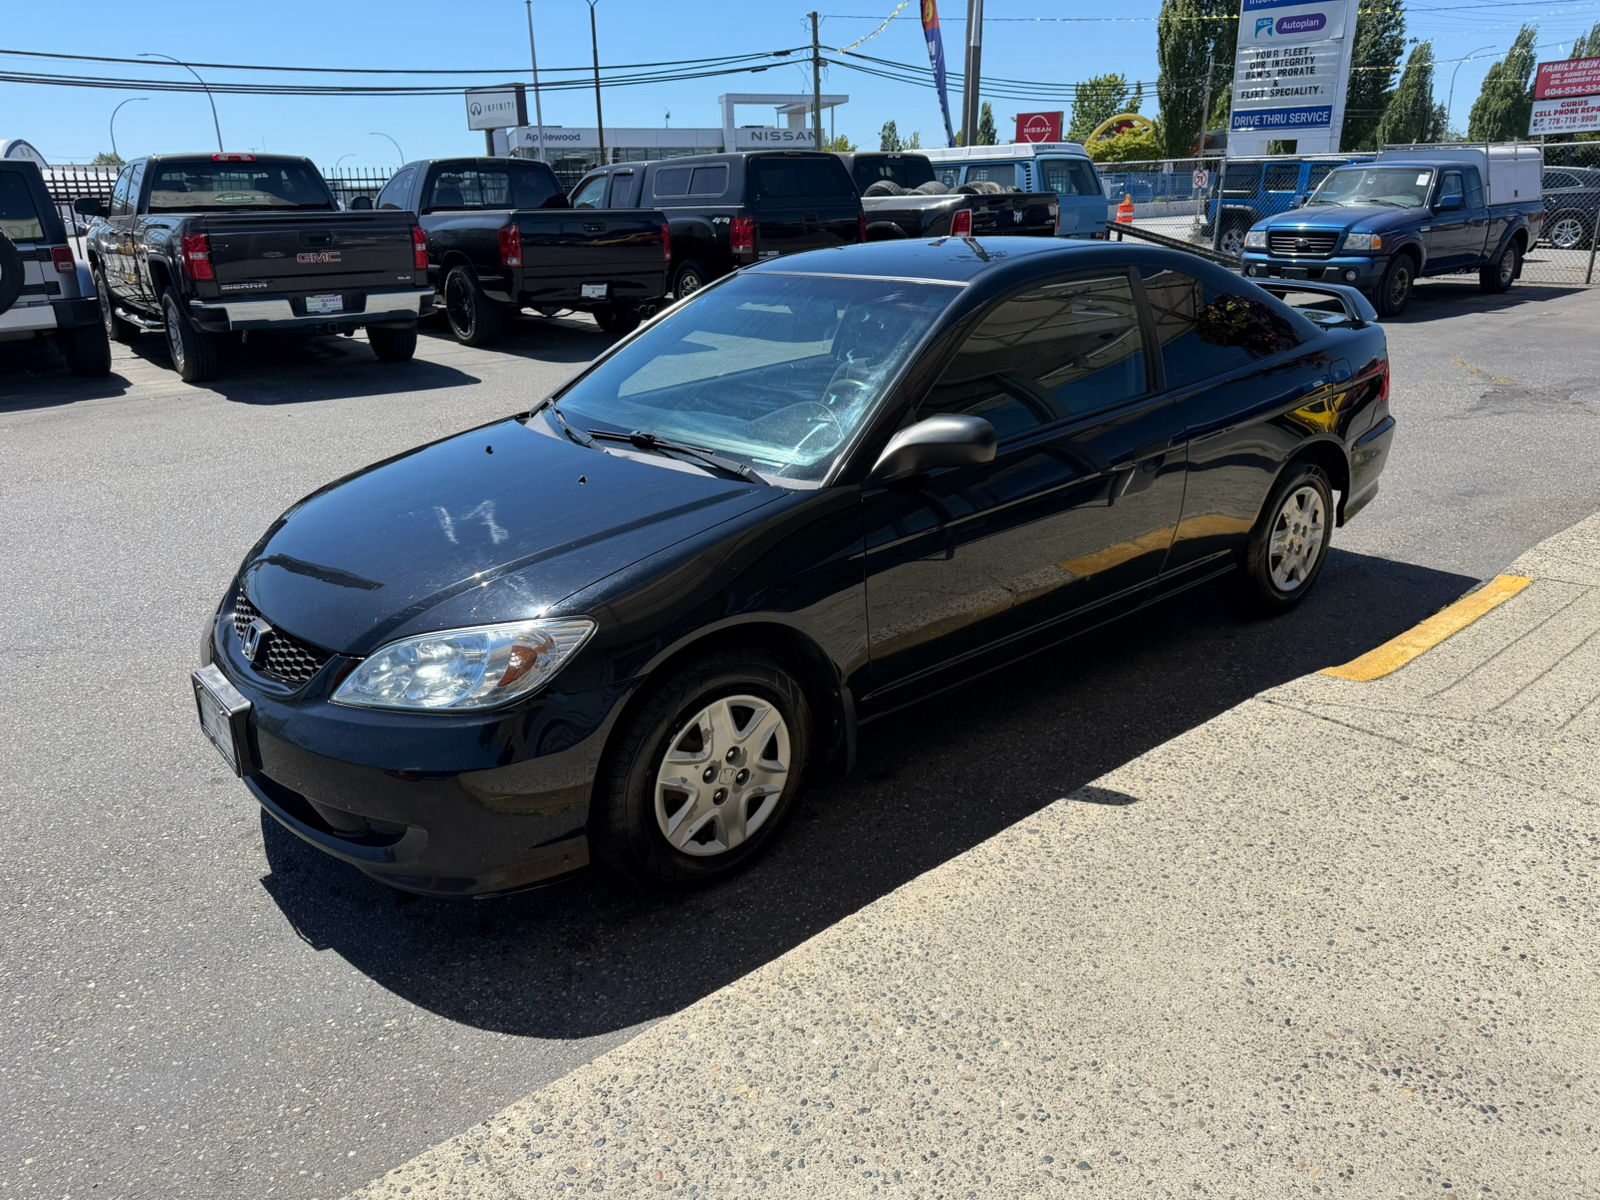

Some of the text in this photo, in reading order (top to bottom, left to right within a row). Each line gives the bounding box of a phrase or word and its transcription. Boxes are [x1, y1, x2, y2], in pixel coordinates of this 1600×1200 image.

[1281, 18, 1320, 31] Autoplan
[1255, 49, 1280, 60] YOUR
[1249, 56, 1316, 70] OUR INTEGRITY
[1542, 60, 1600, 73] FAMILY DEN
[1277, 66, 1316, 77] PRORATE
[1272, 79, 1279, 88] &
[1562, 76, 1592, 84] ANDREW
[1240, 90, 1265, 100] FLEET
[484, 101, 514, 112] INFINITI
[1560, 99, 1589, 108] GURUS
[1534, 109, 1552, 118] CELL
[1553, 107, 1580, 117] PHONE
[1234, 111, 1330, 127] DRIVE THRU SERVICE
[1023, 126, 1052, 134] NISSAN
[525, 133, 581, 143] Aplewood
[751, 131, 816, 141] NISSAN
[296, 251, 342, 264] GMC
[220, 282, 268, 291] SIERRA
